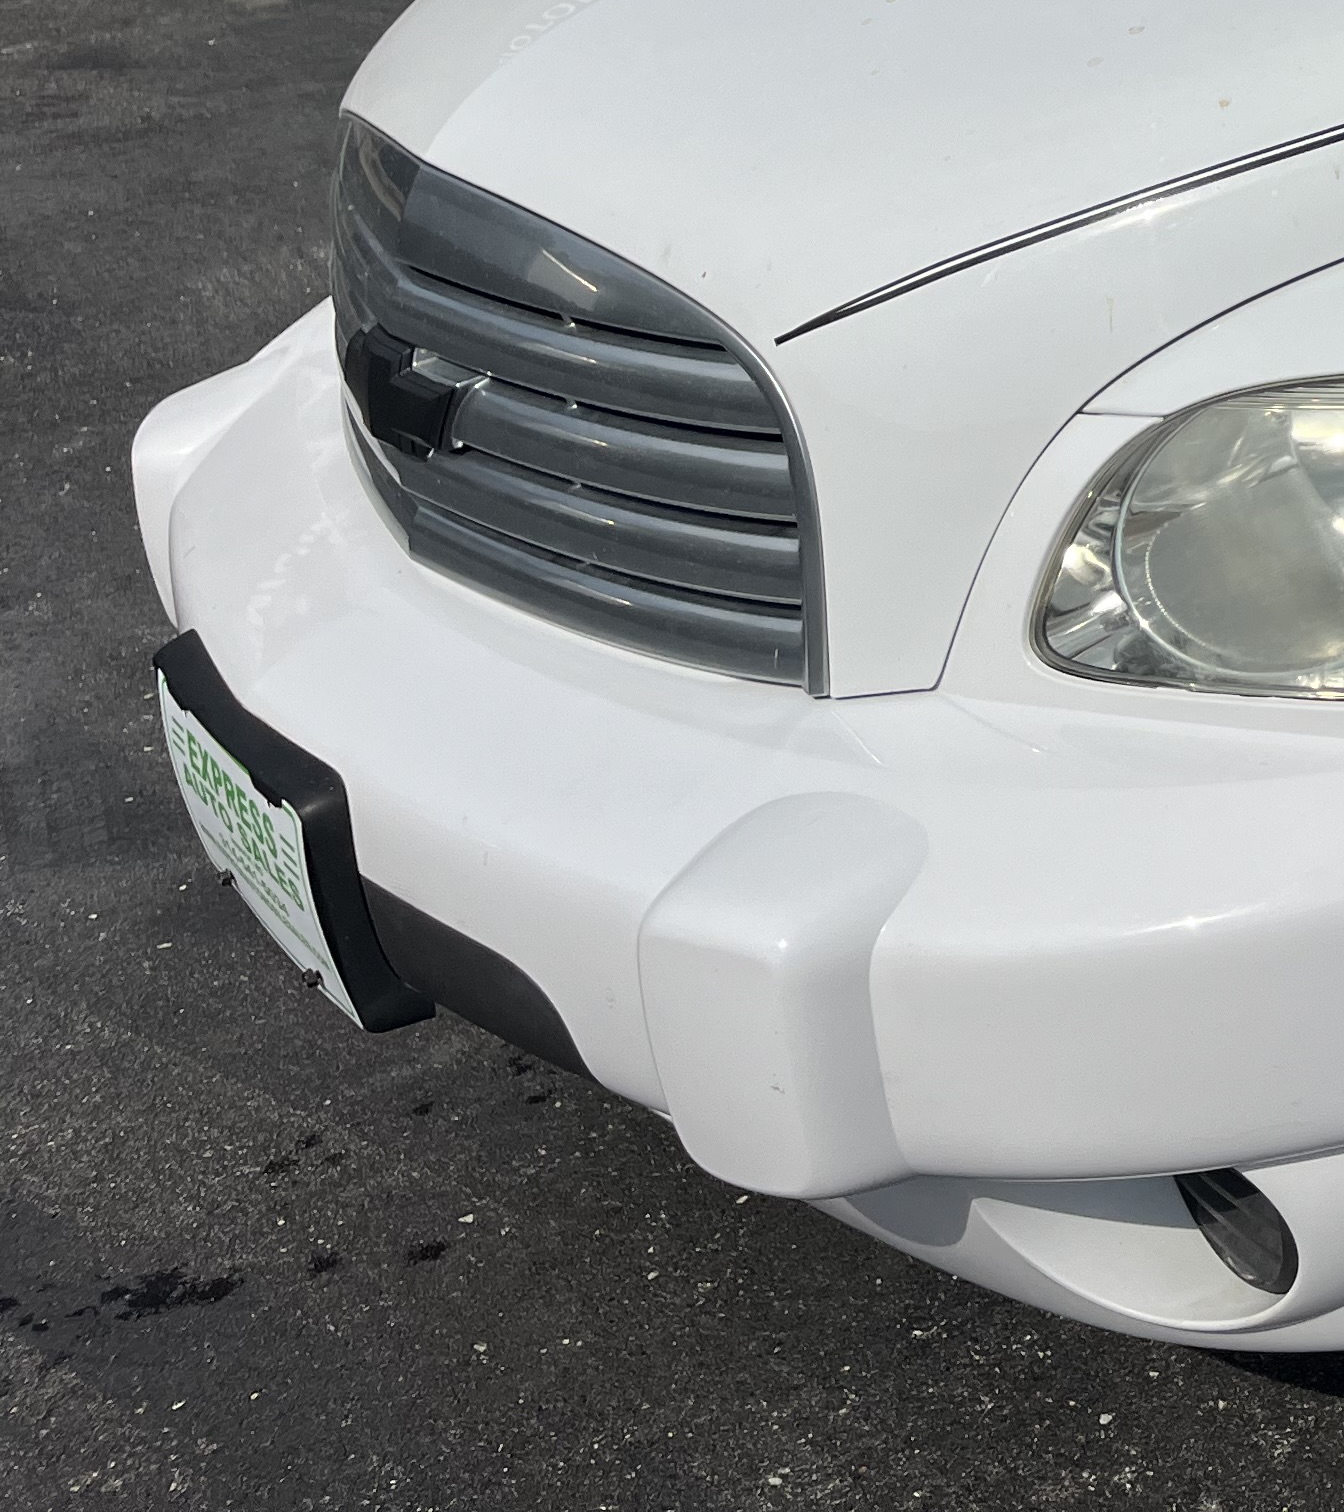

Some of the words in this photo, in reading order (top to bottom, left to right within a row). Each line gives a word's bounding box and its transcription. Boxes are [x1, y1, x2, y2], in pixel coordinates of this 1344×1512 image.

[183, 761, 234, 834] AUTO
[236, 822, 305, 912] SALES
[186, 729, 278, 860] EXPRESS
